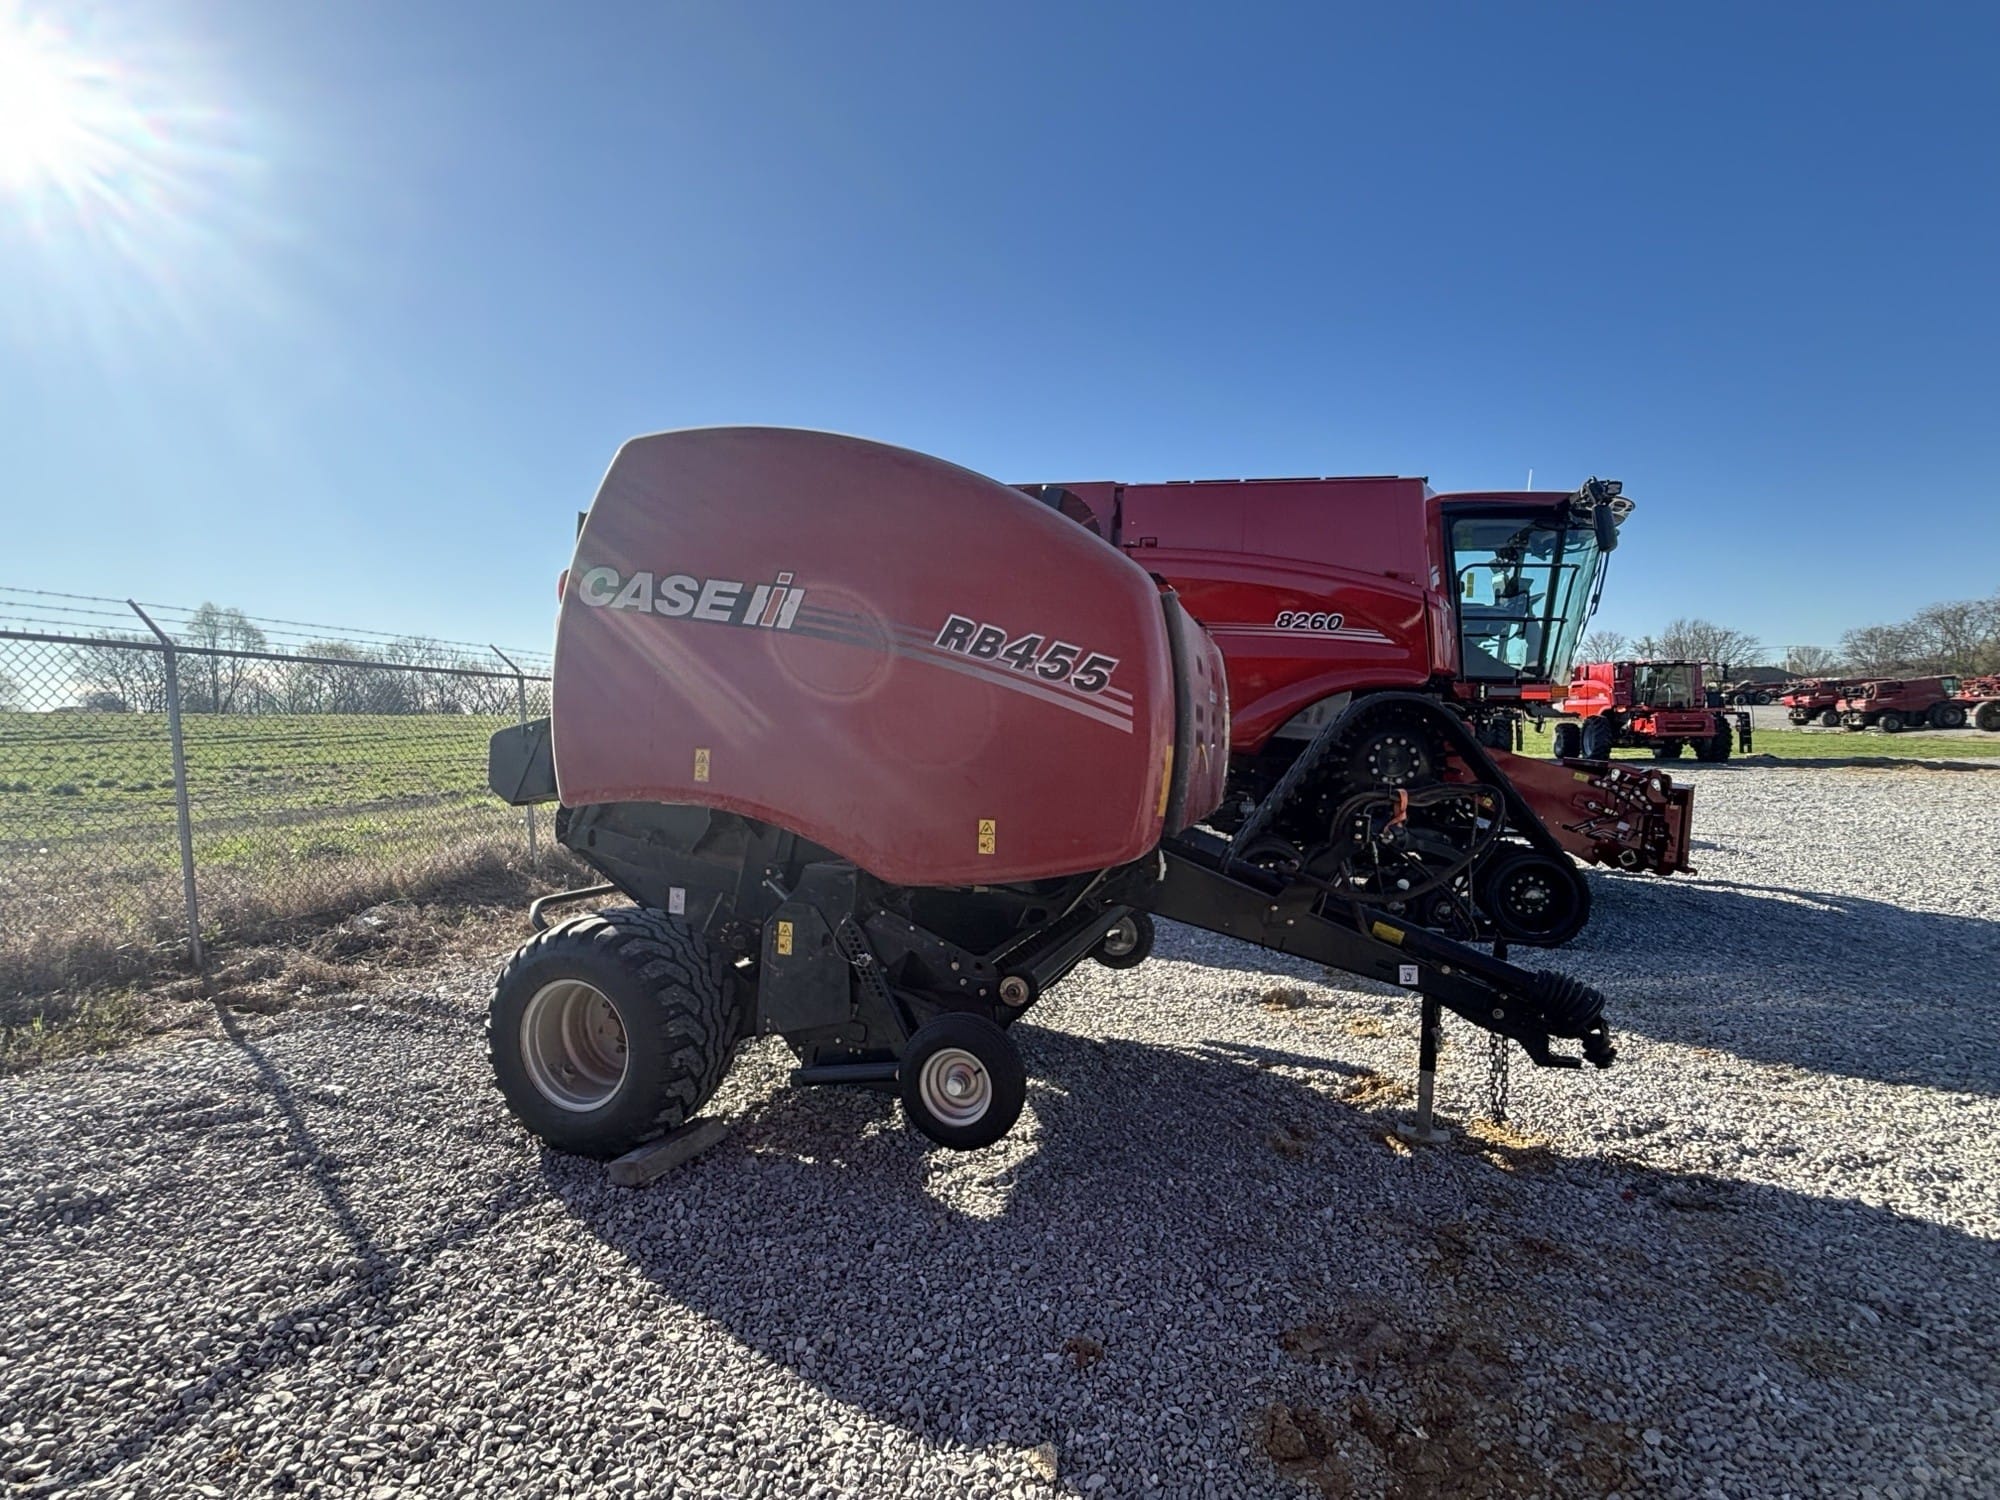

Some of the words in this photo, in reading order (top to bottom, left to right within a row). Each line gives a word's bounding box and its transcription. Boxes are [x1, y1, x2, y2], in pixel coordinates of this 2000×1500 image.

[578, 566, 744, 622] CASE
[1275, 610, 1345, 631] 8260
[934, 613, 1120, 694] RB455
